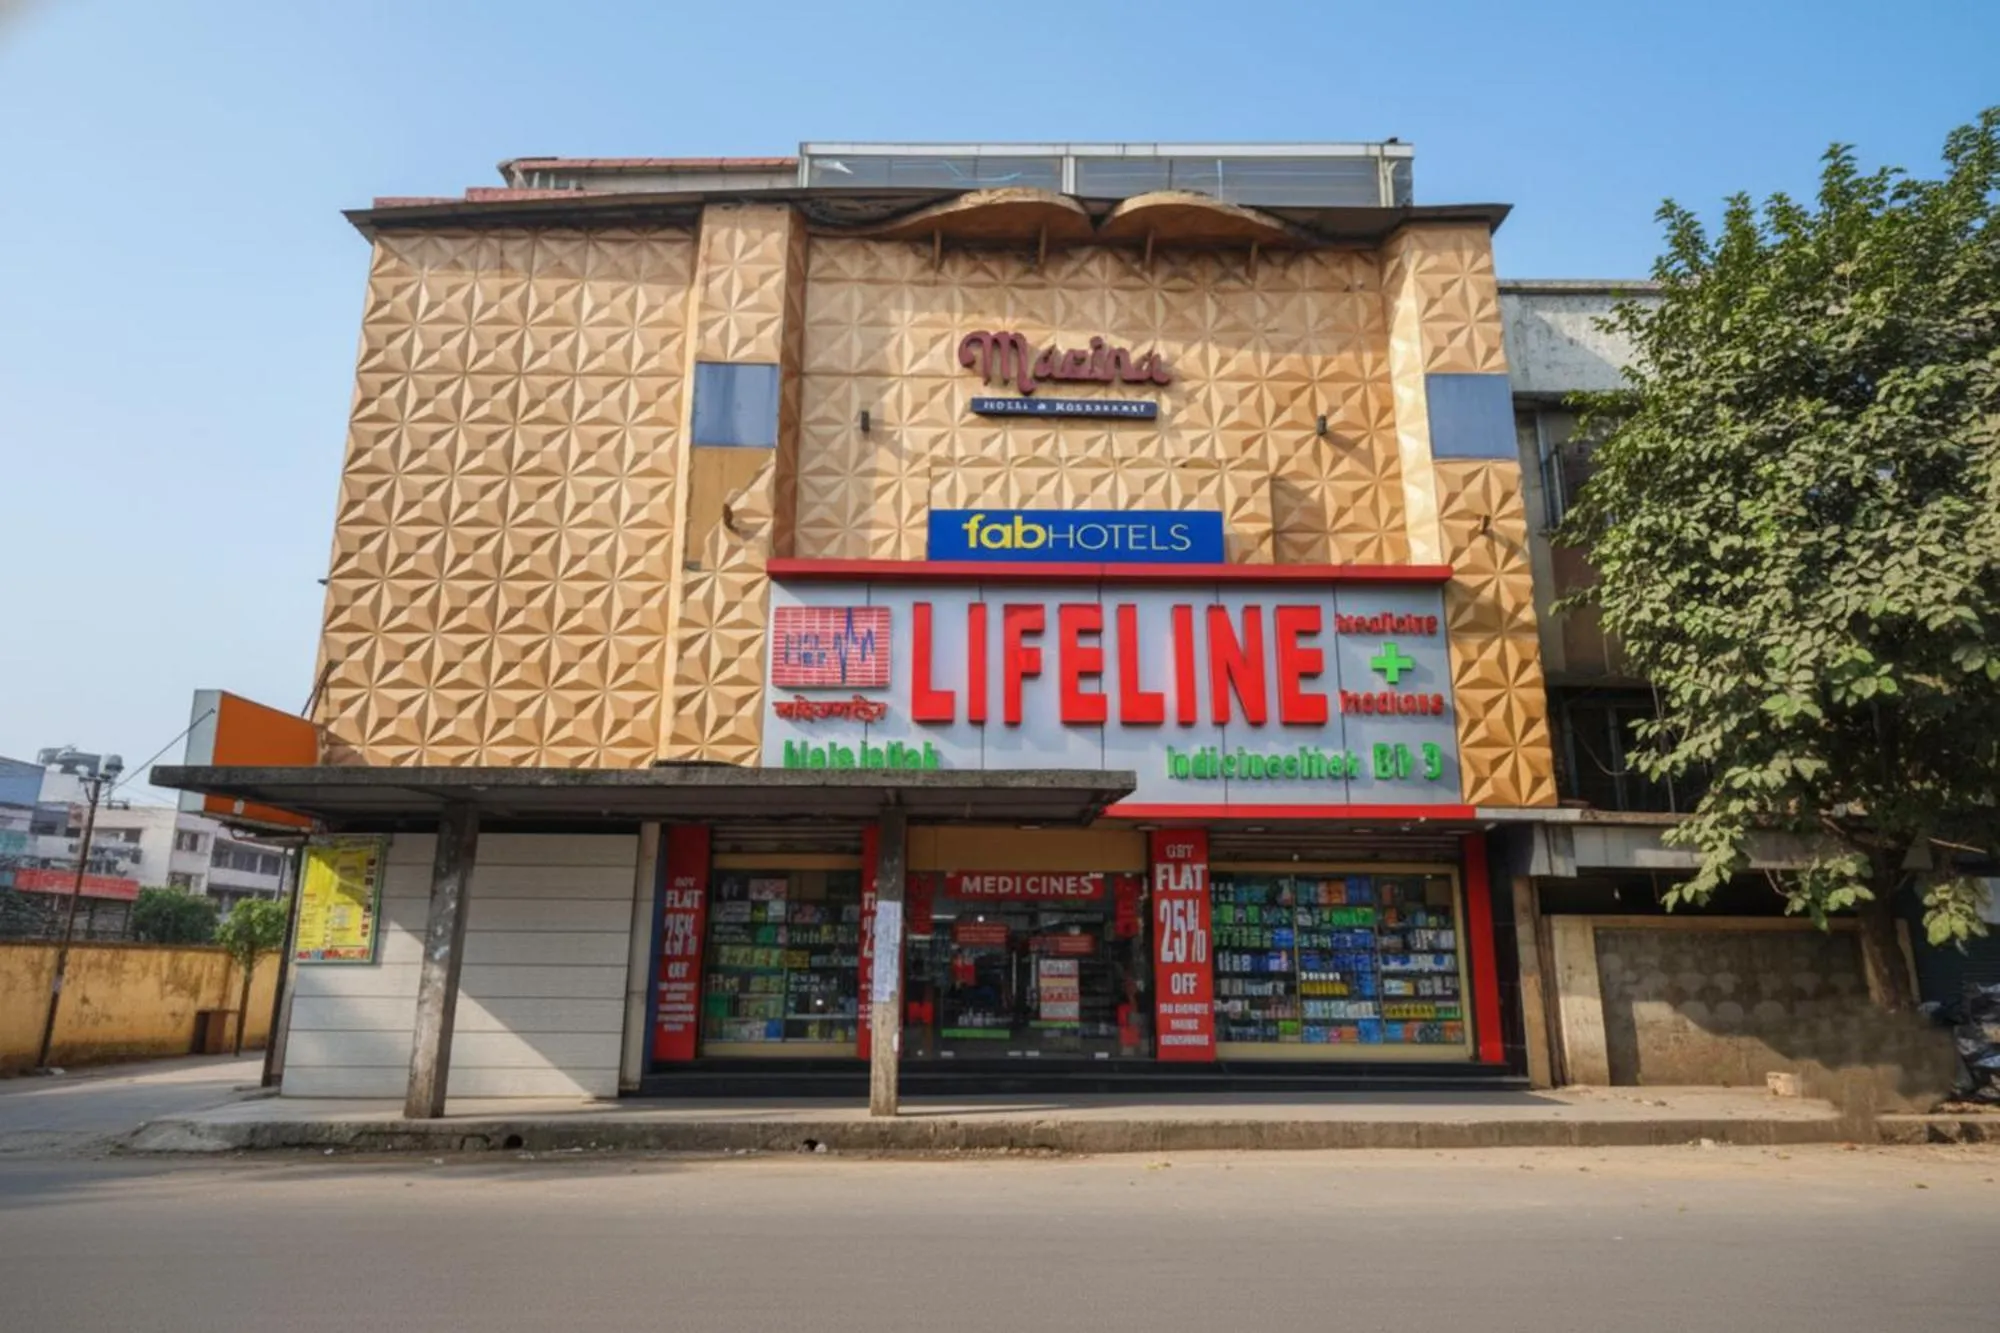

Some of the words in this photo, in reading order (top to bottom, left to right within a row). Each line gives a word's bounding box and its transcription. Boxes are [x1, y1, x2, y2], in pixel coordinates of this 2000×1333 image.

[958, 330, 1170, 394] Marina
[910, 601, 1328, 725] LIFELINE
[961, 875, 1094, 895] MEDICINES
[1155, 863, 1208, 891] FLAT
[665, 889, 703, 908] FLAT
[1159, 898, 1207, 963] 25%
[1171, 973, 1198, 995] OFF
